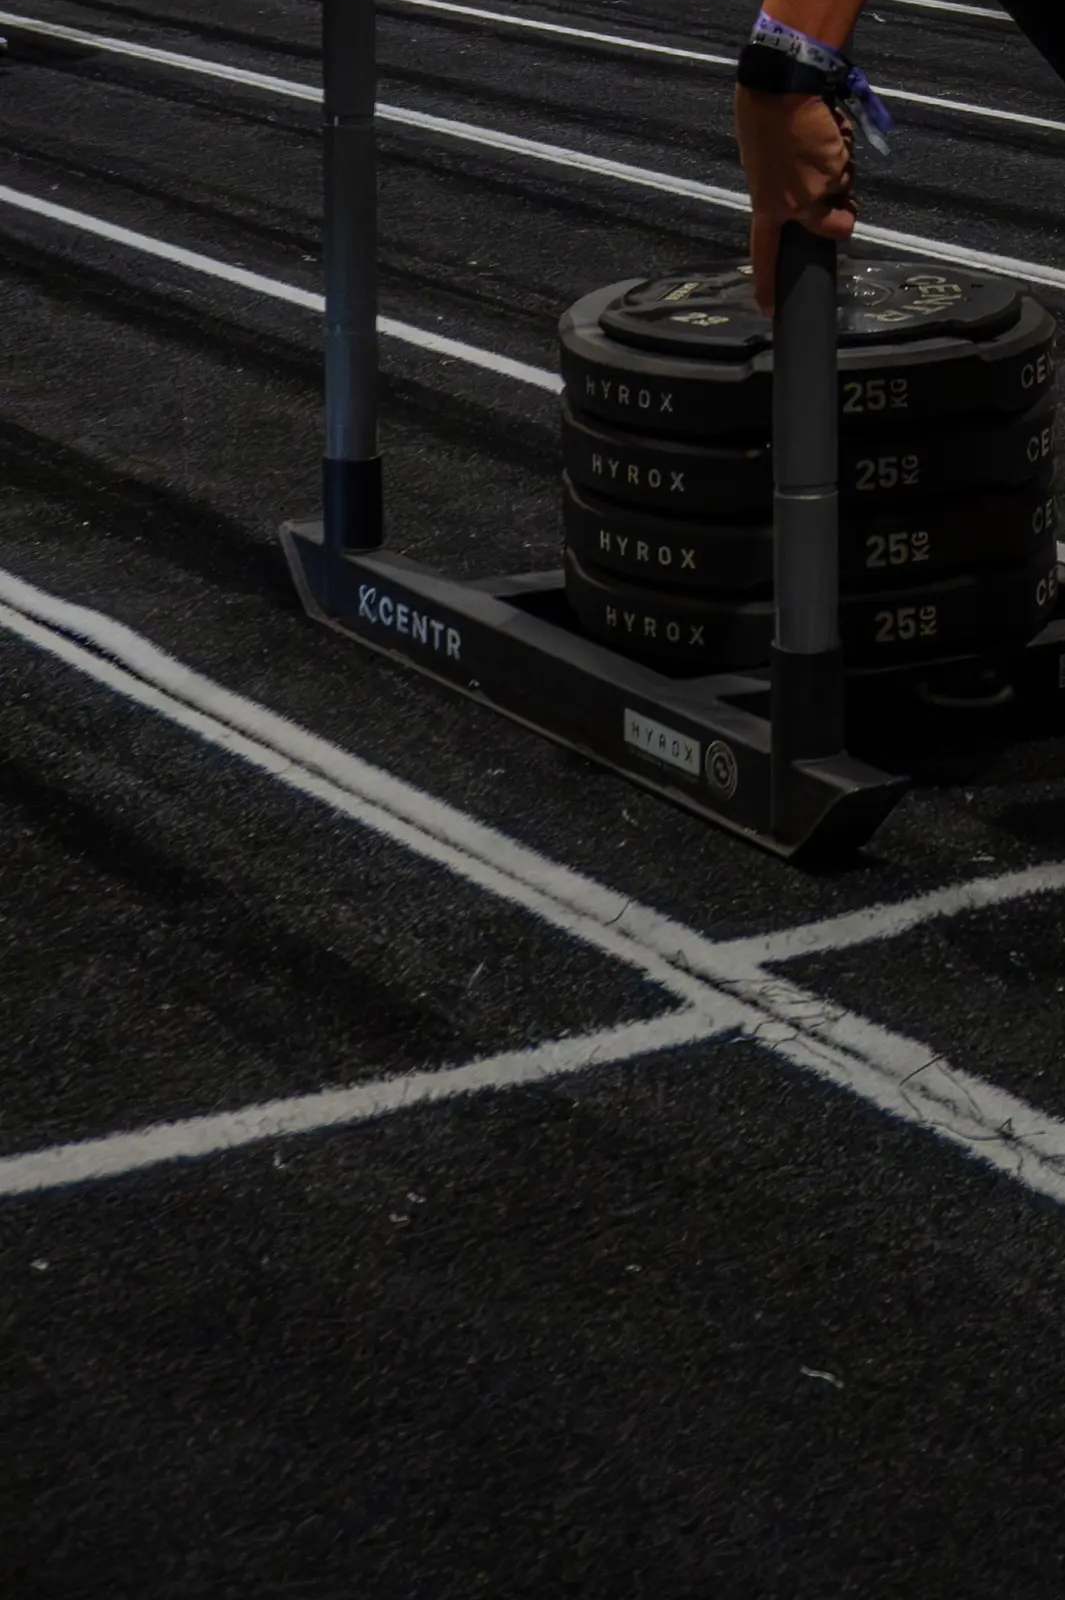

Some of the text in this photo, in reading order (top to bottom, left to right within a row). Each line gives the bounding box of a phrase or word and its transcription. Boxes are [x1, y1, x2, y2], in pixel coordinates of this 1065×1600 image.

[585, 373, 674, 413] HYROX
[592, 453, 685, 493] HYROX
[599, 530, 697, 570] HYROX
[605, 605, 706, 646] HYROX
[630, 720, 693, 764] HYROX
